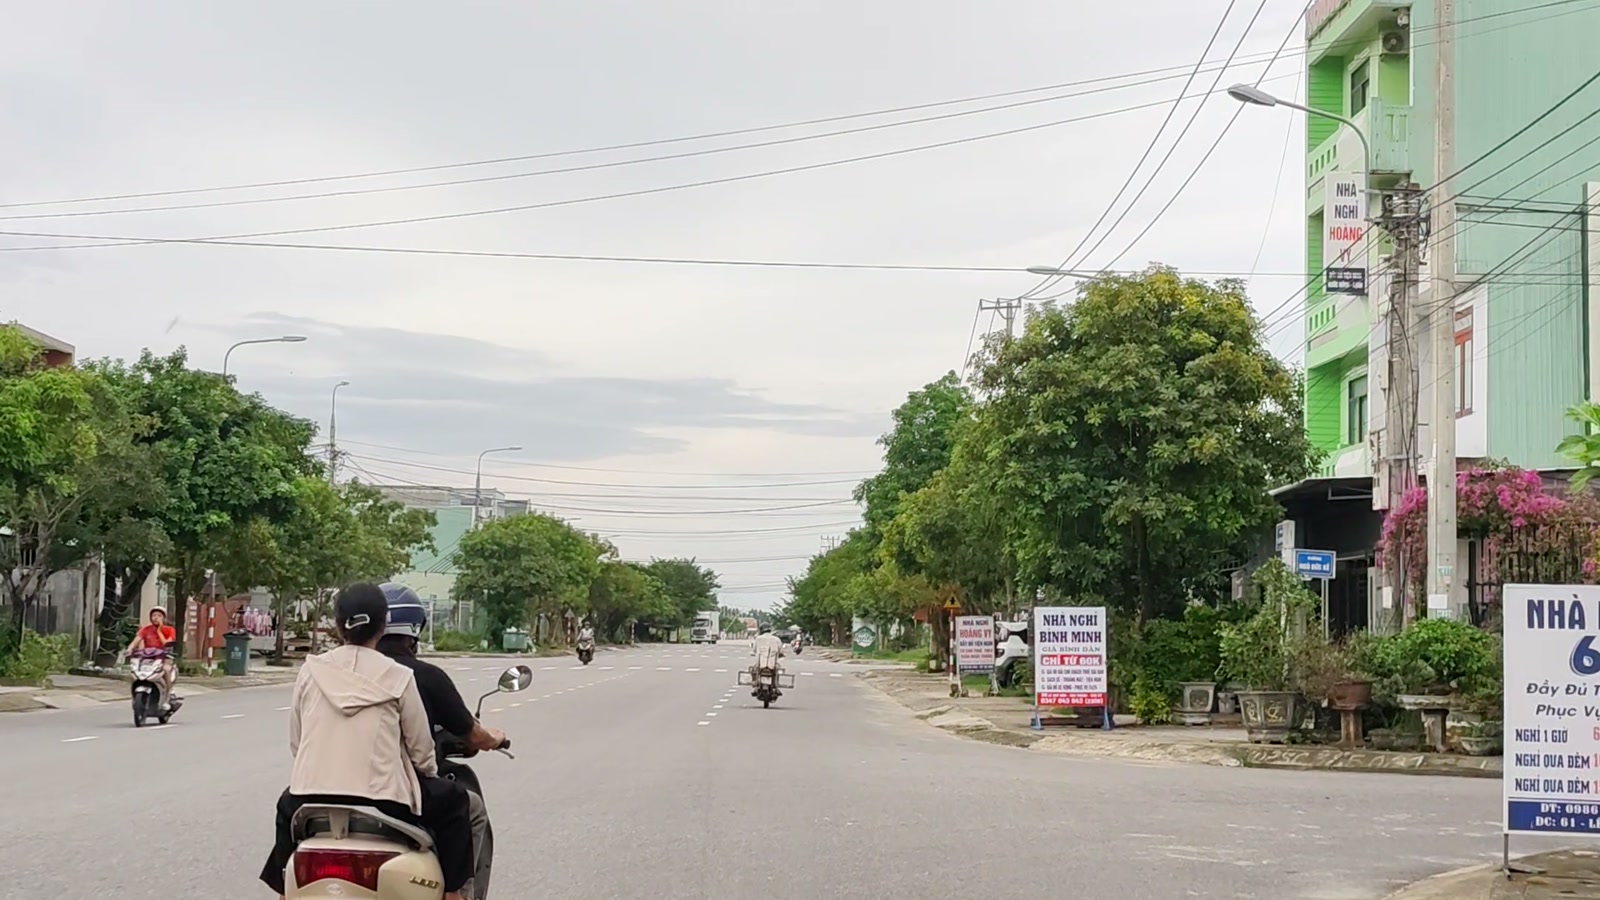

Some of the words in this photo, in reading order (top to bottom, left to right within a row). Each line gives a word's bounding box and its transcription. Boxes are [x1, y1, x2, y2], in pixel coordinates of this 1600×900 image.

[1336, 180, 1357, 198] NHÀ
[1334, 200, 1359, 219] NGHỈ
[1329, 223, 1363, 241] HOÀNG
[1043, 611, 1066, 626] NHÀ
[1069, 611, 1098, 626] NGHỈ
[1527, 594, 1586, 630] NHÀ
[1039, 628, 1068, 643] BÌNH
[1071, 631, 1102, 643] MINH
[1042, 655, 1060, 665] CHỈ
[1063, 655, 1078, 665] TỪ
[1080, 656, 1100, 665] 60K
[1526, 679, 1560, 698] Đầy
[1565, 682, 1588, 696] Đủ
[1536, 704, 1577, 720] Phục
[1515, 724, 1540, 743] NGHỈ
[1543, 729, 1548, 743] 1
[1551, 726, 1568, 743] GIỜ
[1515, 749, 1540, 767] NGHỈ
[1543, 754, 1564, 768] QUA
[1567, 752, 1590, 769] ĐÊM
[1515, 774, 1540, 792] NGHỈ
[1543, 779, 1564, 793] QUA
[1567, 776, 1590, 794] ĐÊM
[1565, 804, 1598, 815] 0986
[1560, 817, 1576, 828] 61
